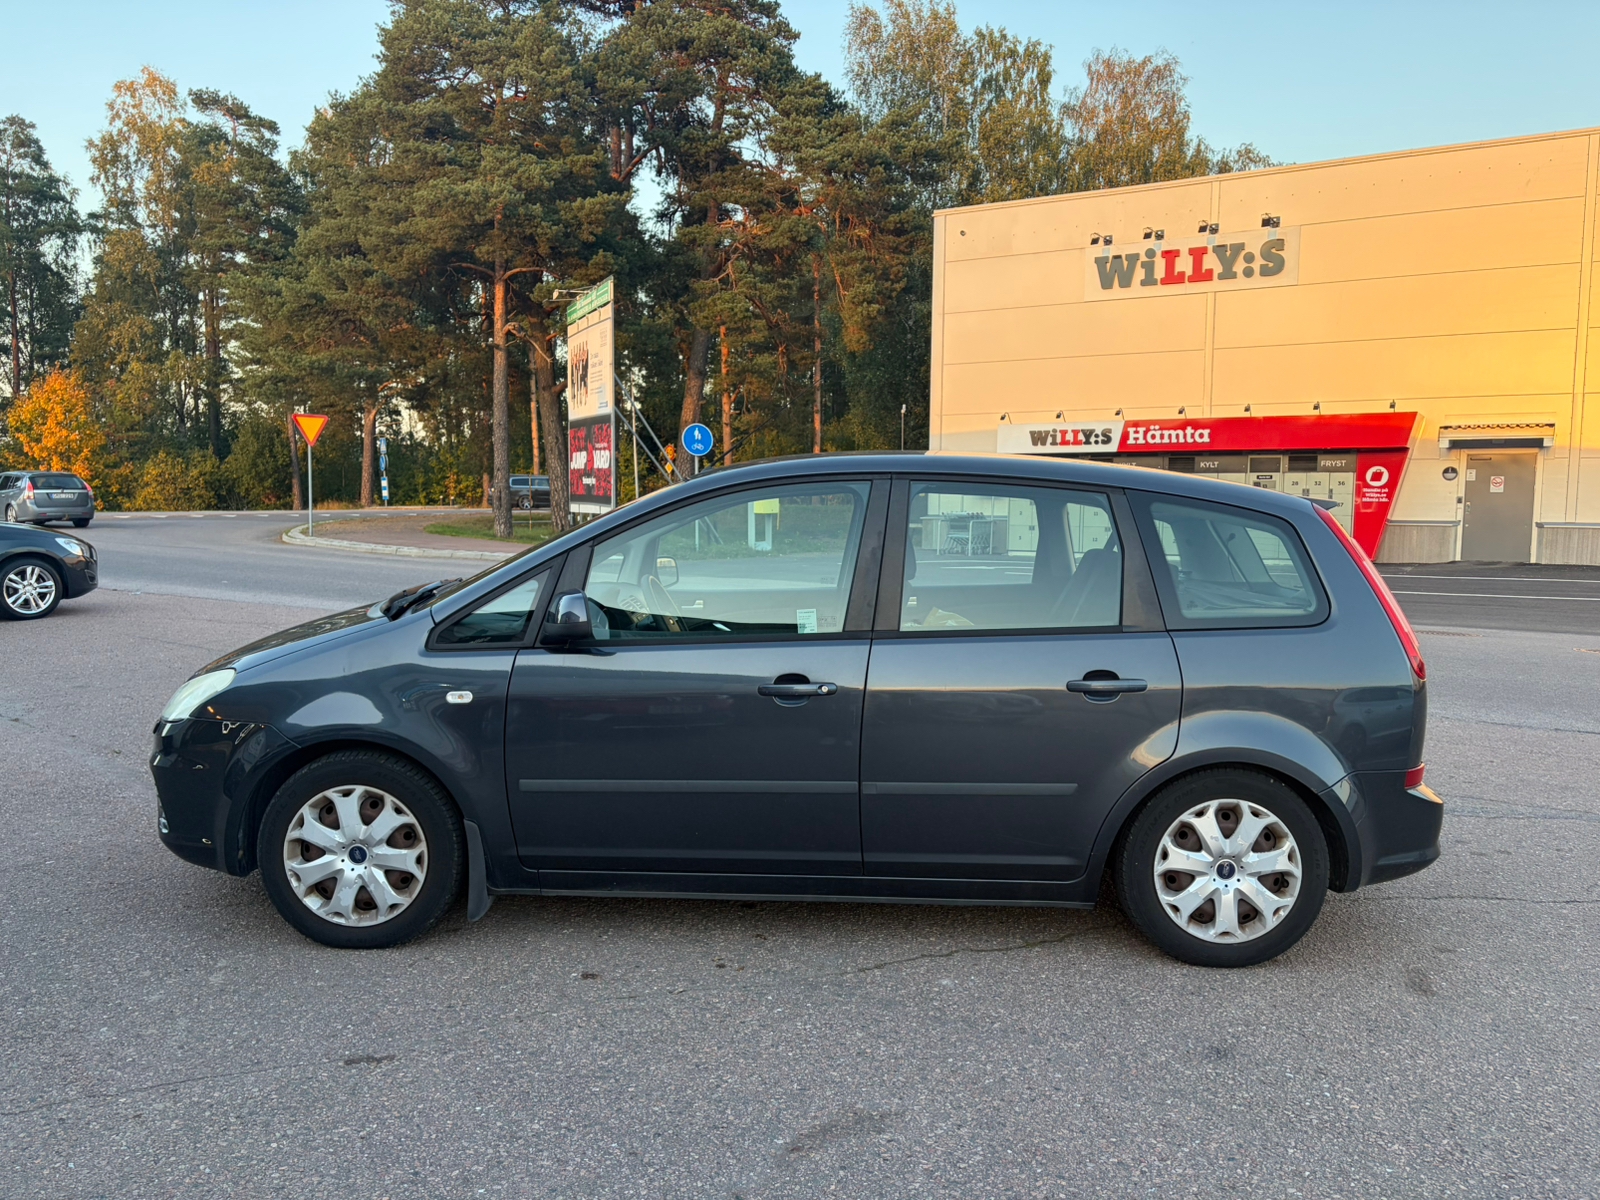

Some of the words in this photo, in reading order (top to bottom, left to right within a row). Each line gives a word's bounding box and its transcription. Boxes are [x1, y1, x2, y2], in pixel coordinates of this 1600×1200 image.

[1094, 238, 1285, 290] WiLLY:S
[1029, 428, 1112, 447] WiLLY:S
[1126, 425, 1211, 445] Hämta
